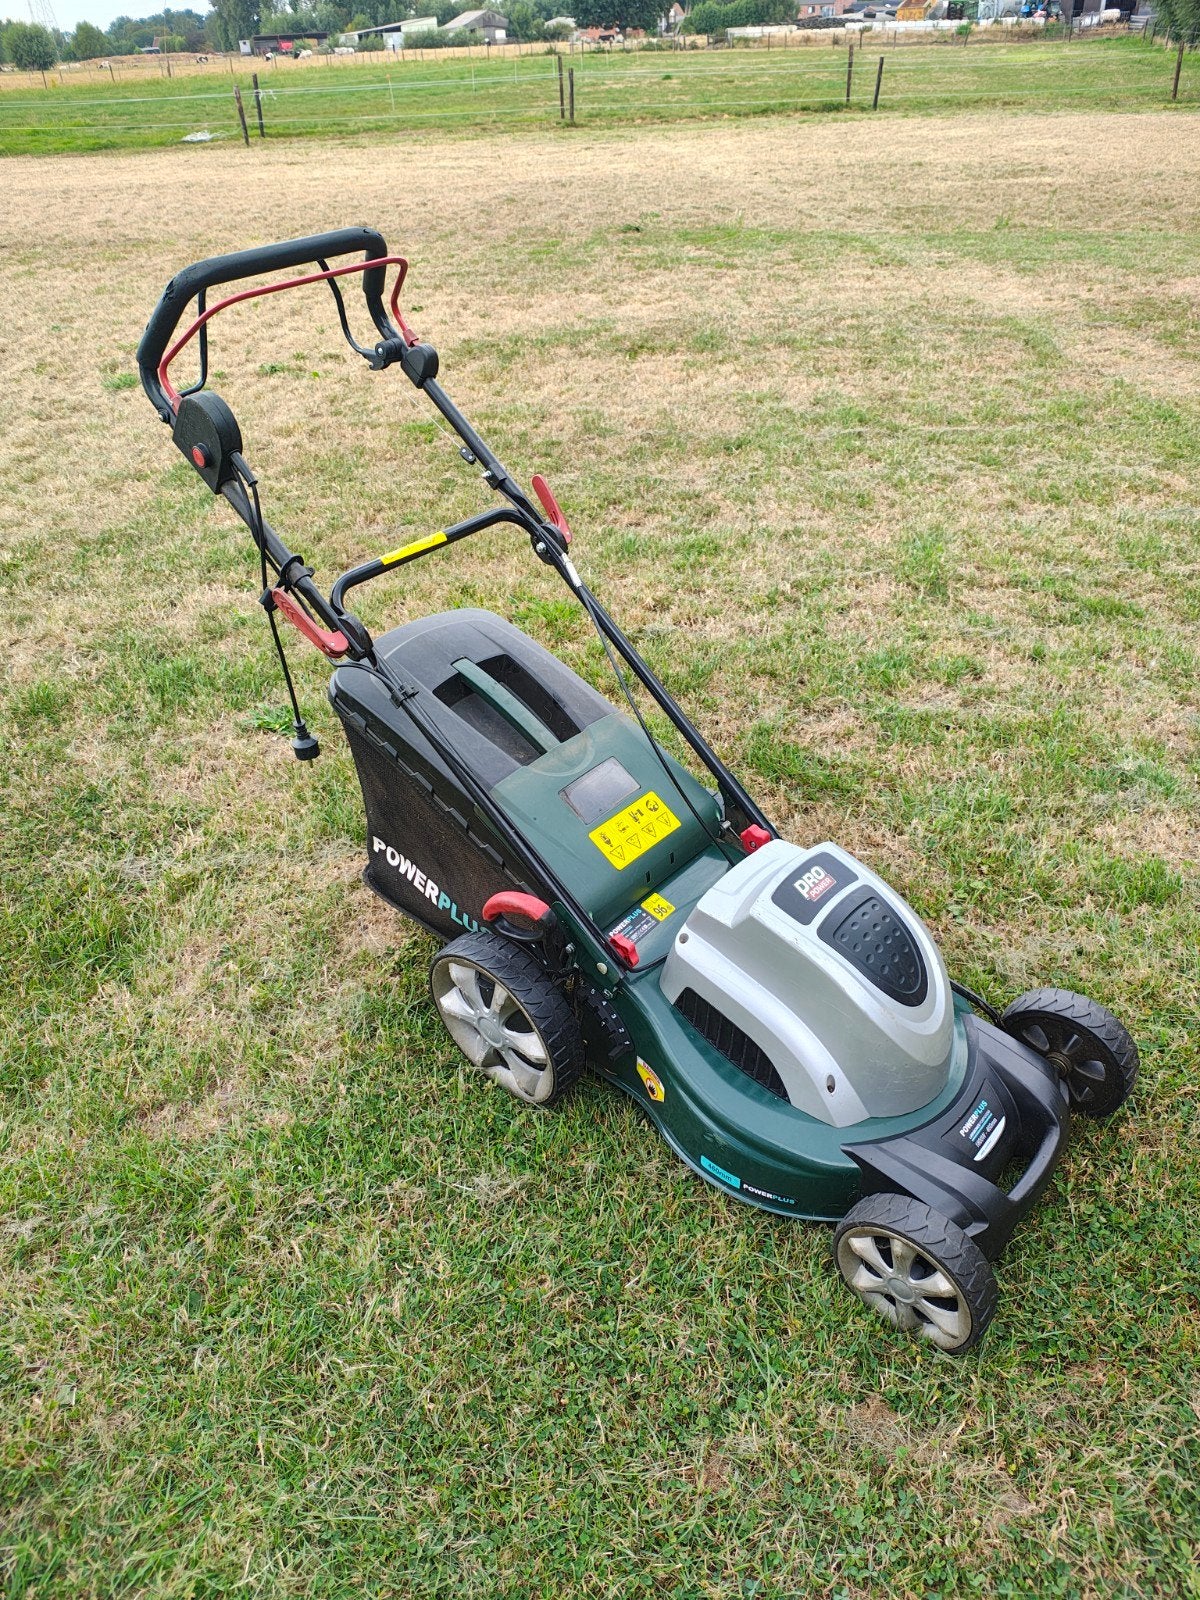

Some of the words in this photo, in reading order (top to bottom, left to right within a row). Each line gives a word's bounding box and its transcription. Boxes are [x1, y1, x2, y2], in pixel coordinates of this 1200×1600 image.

[793, 865, 827, 899] PRO
[809, 877, 833, 899] POWER
[608, 908, 642, 937] POWERPLUS
[653, 904, 668, 917] 96
[959, 1099, 988, 1137] POWERPLUS
[742, 1183, 796, 1205] POWERPLUS
